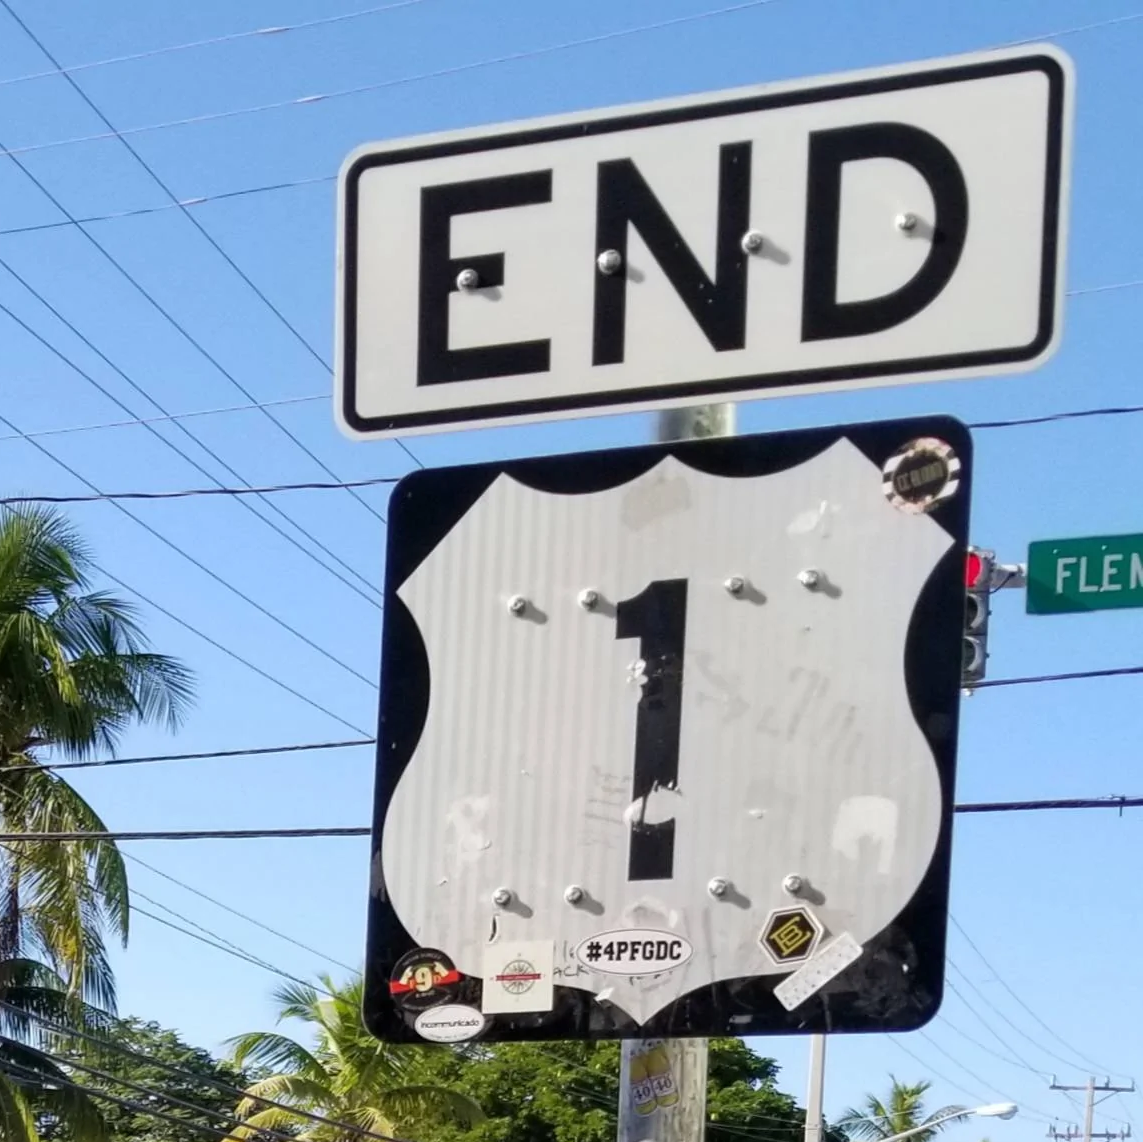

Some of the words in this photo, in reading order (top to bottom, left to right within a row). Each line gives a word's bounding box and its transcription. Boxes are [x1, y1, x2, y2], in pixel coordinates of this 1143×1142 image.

[417, 121, 969, 387] END
[615, 578, 688, 882] 1
[586, 940, 682, 962] #4PFGDC
